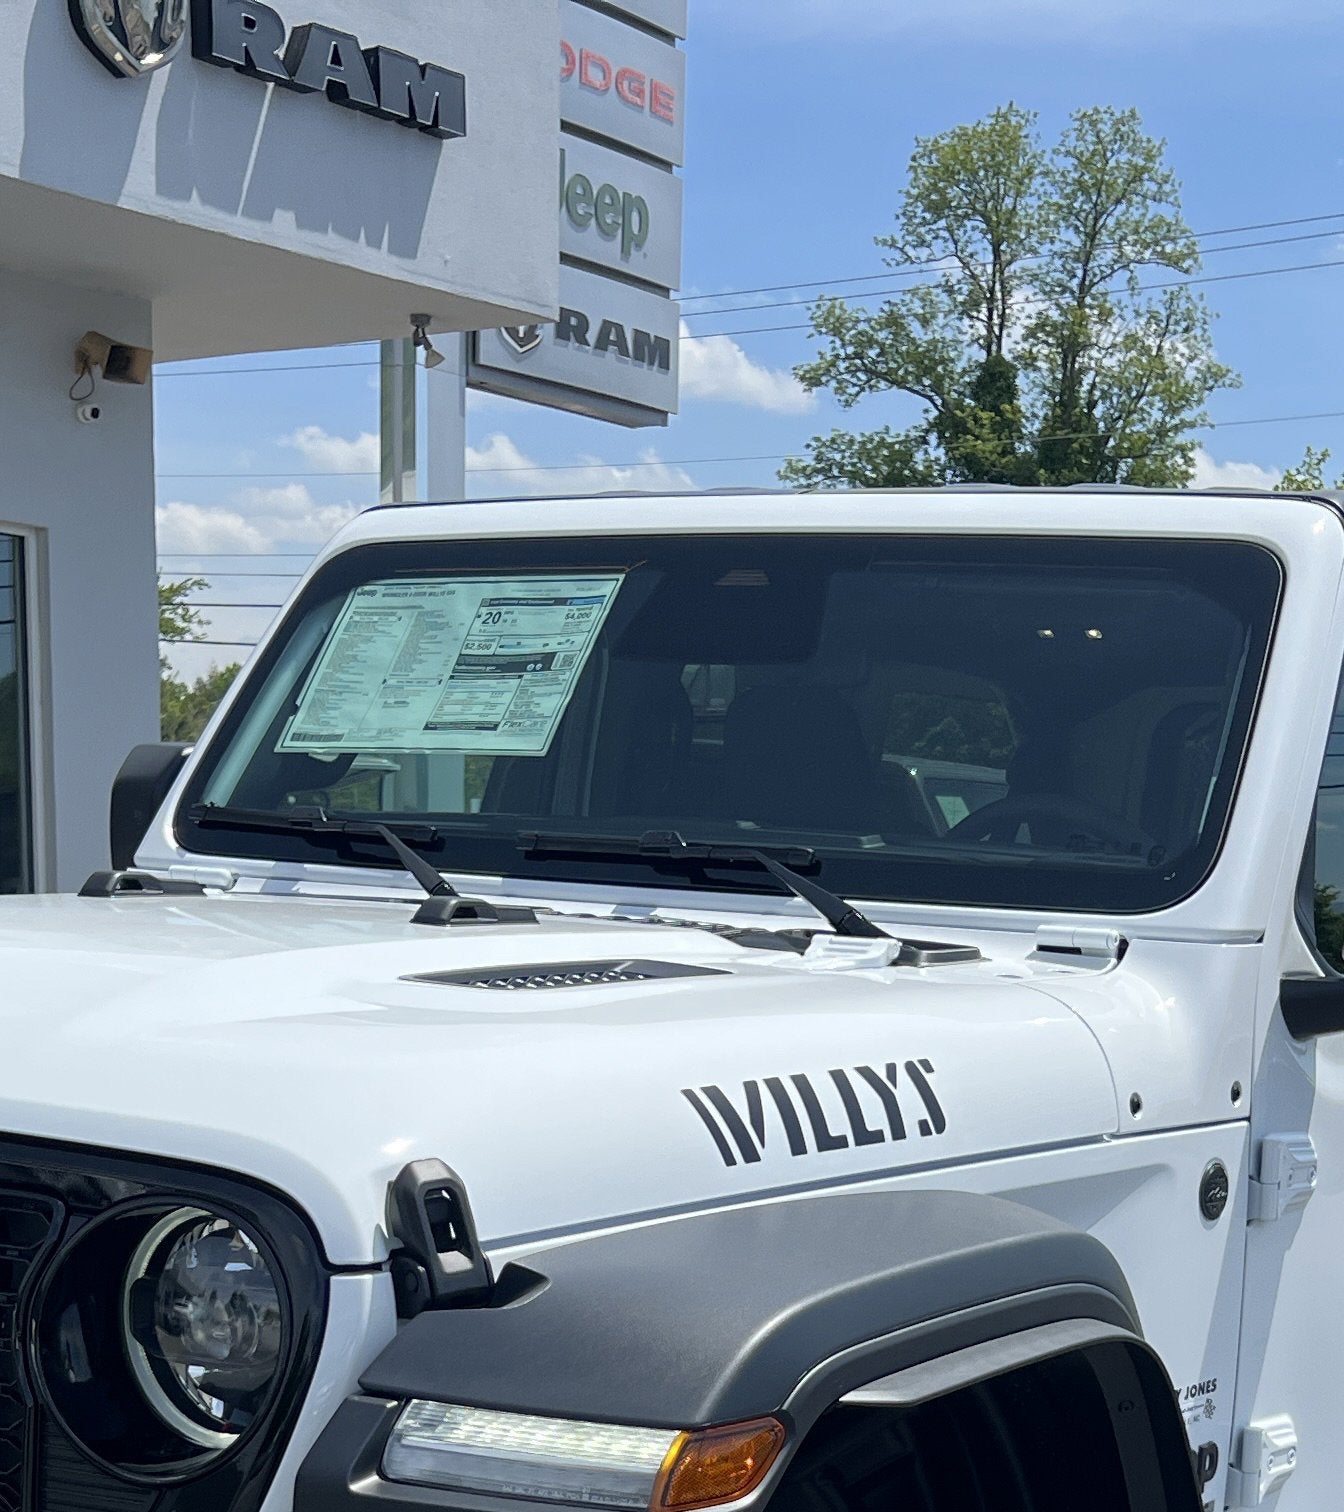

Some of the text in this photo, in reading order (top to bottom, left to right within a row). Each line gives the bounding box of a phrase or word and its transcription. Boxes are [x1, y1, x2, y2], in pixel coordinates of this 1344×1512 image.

[192, 0, 466, 140] RAM
[554, 305, 671, 371] RAM
[481, 611, 502, 625] 20
[679, 1057, 947, 1168] WILLYS
[1184, 1377, 1217, 1401] JONES
